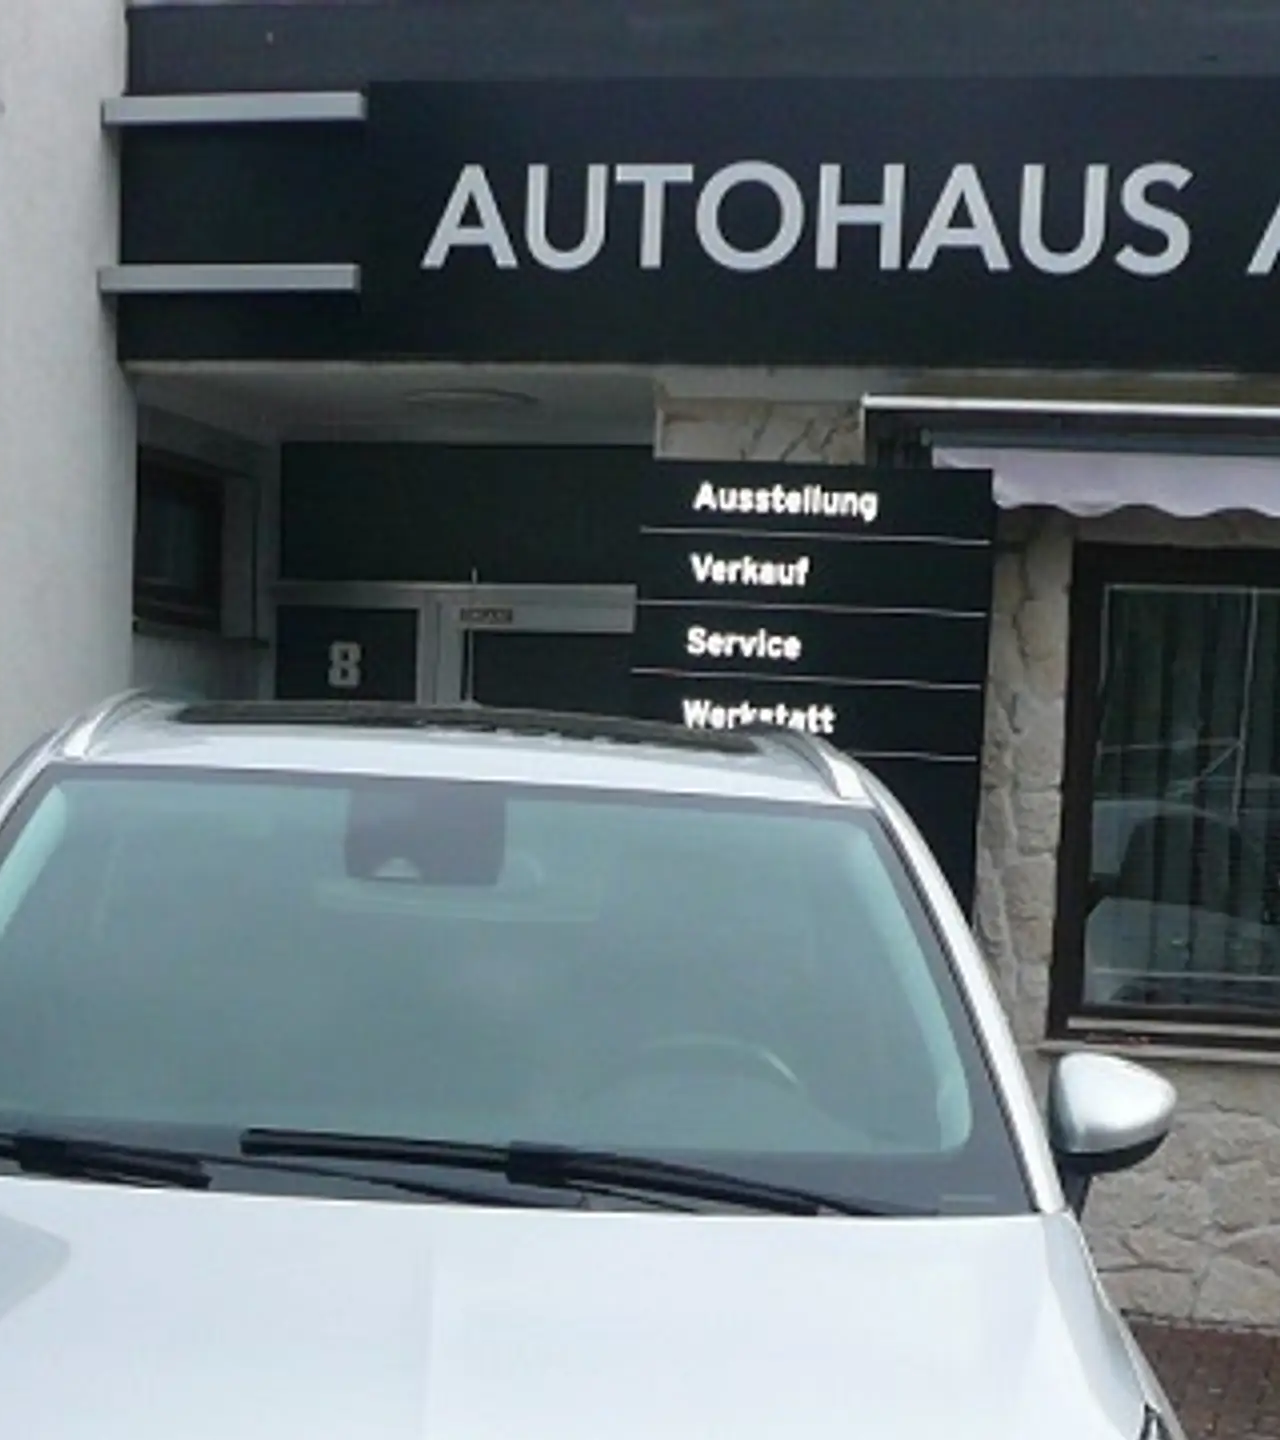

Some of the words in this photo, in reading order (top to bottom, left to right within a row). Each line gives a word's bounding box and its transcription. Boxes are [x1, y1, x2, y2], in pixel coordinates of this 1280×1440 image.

[421, 160, 1194, 276] AUTOHAUS
[692, 480, 880, 523] Ausstellung
[689, 551, 811, 588] Verkauf
[328, 641, 362, 688] 8
[685, 625, 803, 662] Service
